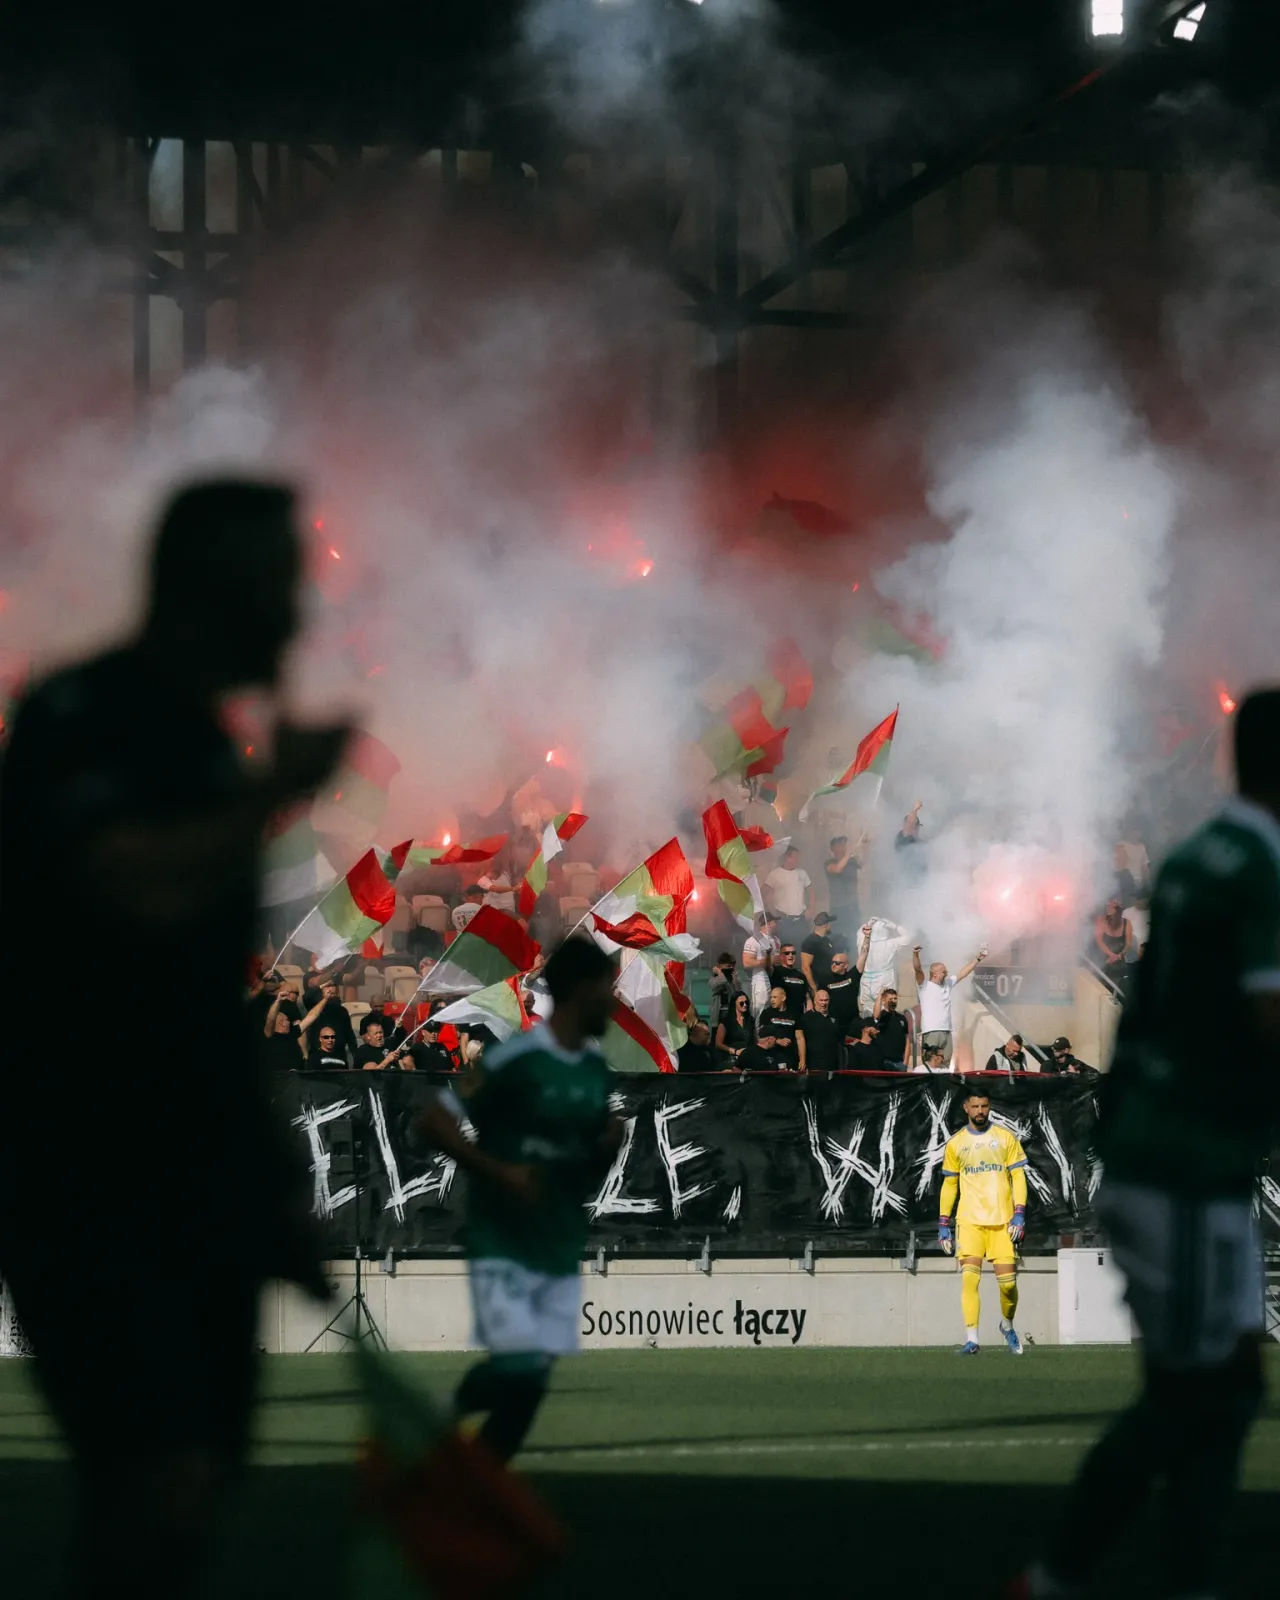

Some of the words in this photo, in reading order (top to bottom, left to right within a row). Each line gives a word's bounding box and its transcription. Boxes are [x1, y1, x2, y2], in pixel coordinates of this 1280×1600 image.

[996, 974, 1024, 997] 07
[581, 1301, 724, 1336] Sosnowiec
[733, 1299, 807, 1345] łączy
